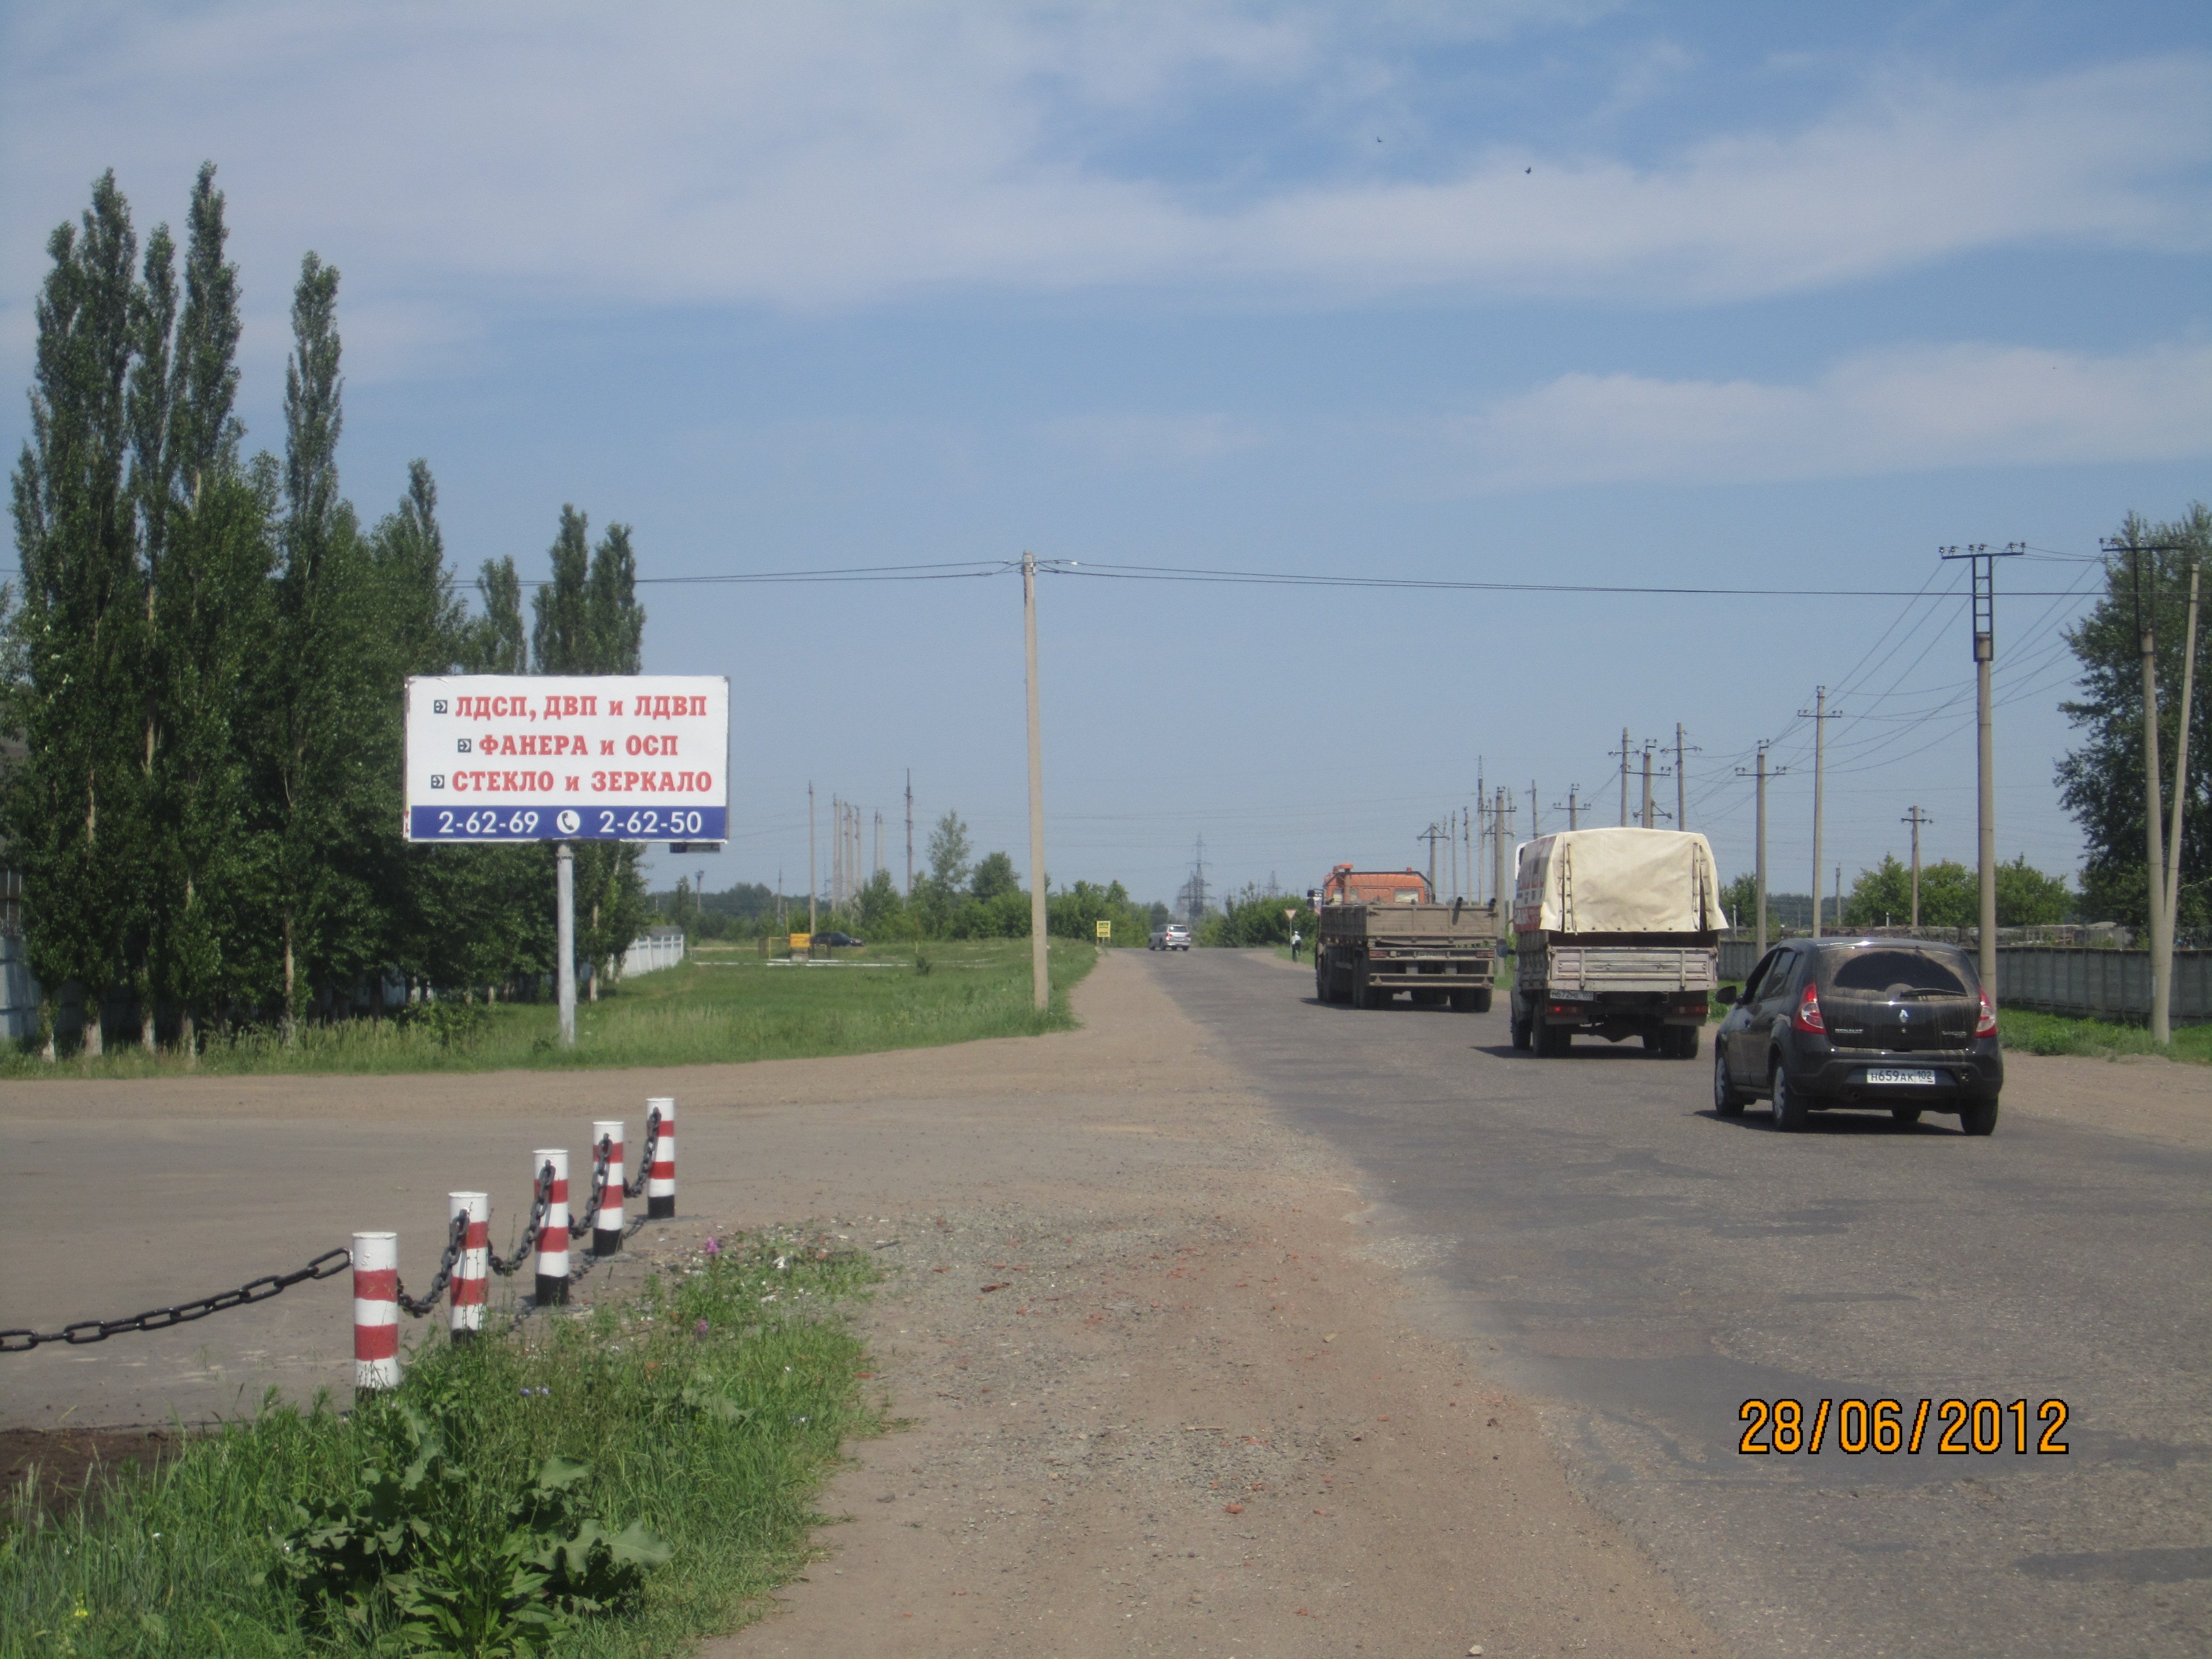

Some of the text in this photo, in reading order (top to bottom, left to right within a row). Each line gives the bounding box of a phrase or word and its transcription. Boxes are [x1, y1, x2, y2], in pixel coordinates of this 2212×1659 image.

[455, 695, 707, 720] ЛДСП, ДВП и ЛДВП
[479, 734, 678, 756] ФАНЕРА и ОСП
[452, 770, 713, 793] СТЕКЛО и ЗЕРКАЛО
[438, 811, 702, 834] 2-62-69 2-62-50
[1917, 1071, 1932, 1079] 102
